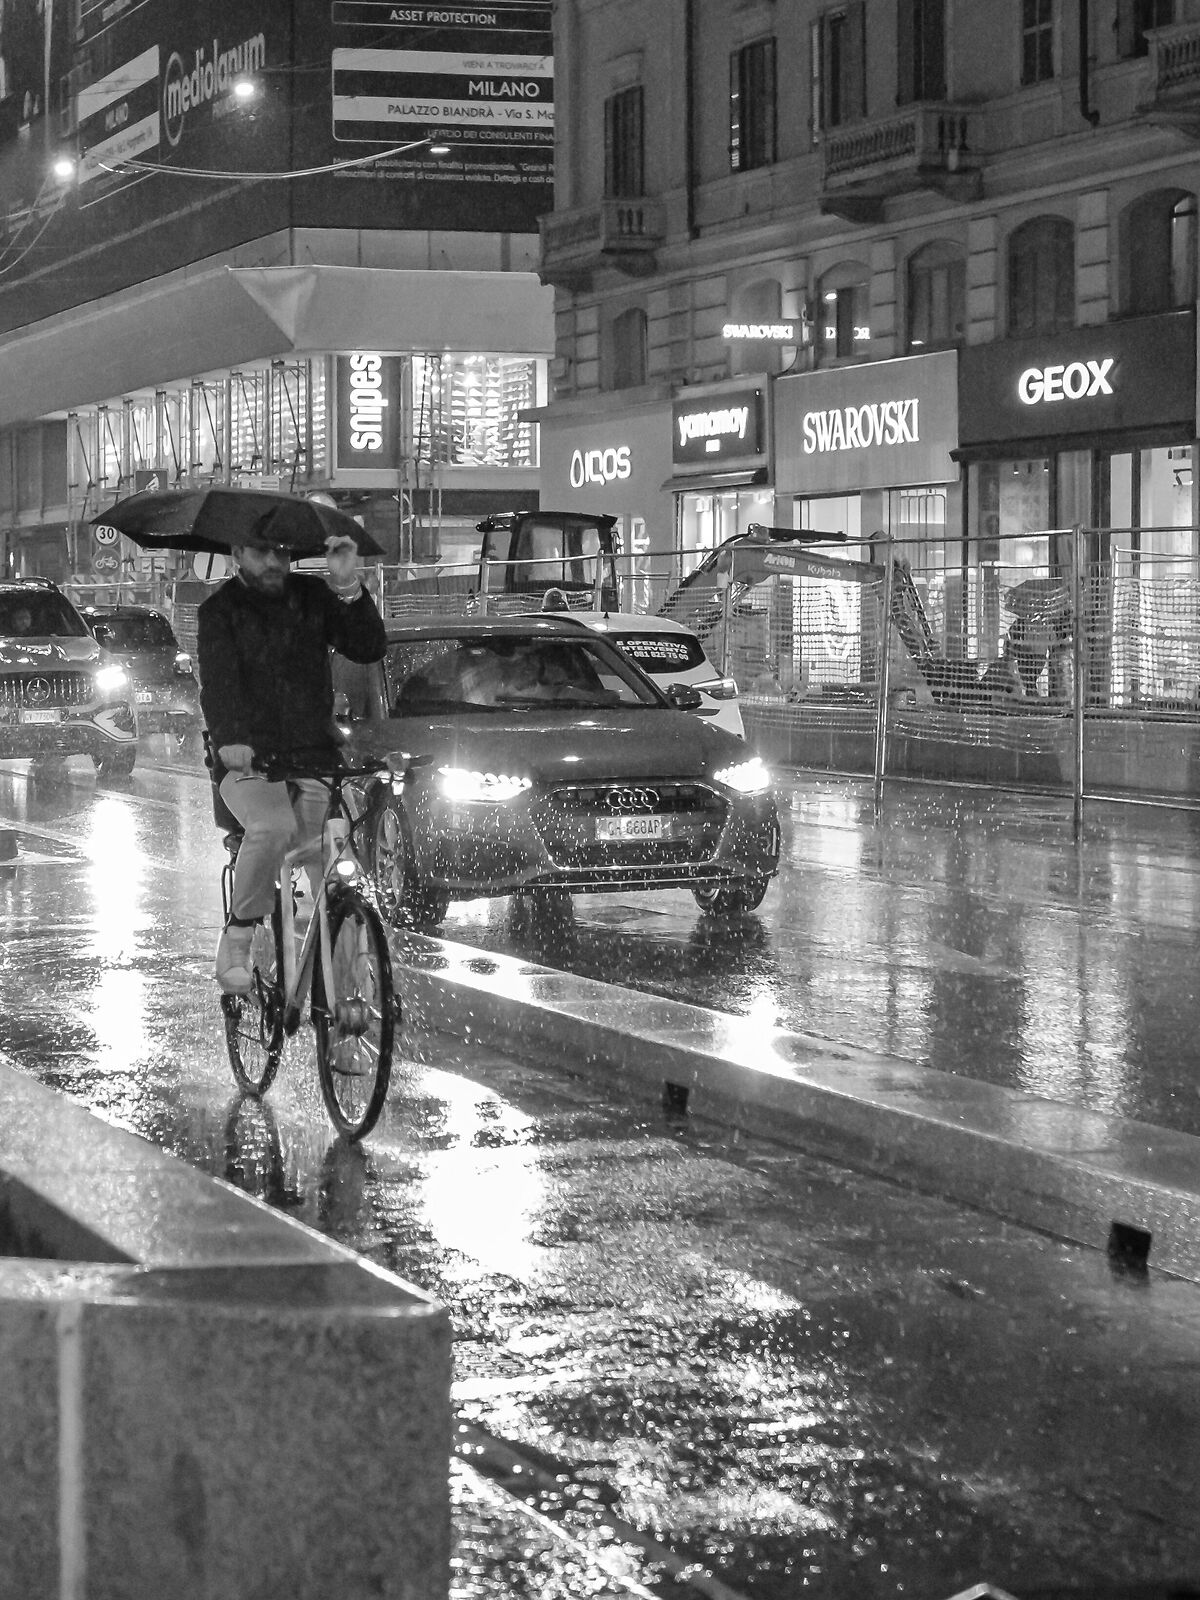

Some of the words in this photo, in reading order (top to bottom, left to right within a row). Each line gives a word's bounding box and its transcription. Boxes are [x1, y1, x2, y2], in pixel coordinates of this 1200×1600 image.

[390, 10, 423, 22] ASSET
[427, 11, 497, 25] PROTECTION
[167, 32, 266, 120] mediolanum
[468, 80, 540, 98] MILANO
[387, 104, 440, 117] PALAZZO
[505, 108, 523, 119] Via
[526, 109, 534, 120] S.
[722, 324, 794, 339] SWAROVSKI
[1018, 358, 1115, 405] GEOX
[350, 354, 389, 450] snipes
[678, 406, 749, 447] yamamay
[803, 398, 920, 454] SWAROVSKI
[584, 446, 632, 486] IQOS
[99, 527, 114, 540] 30
